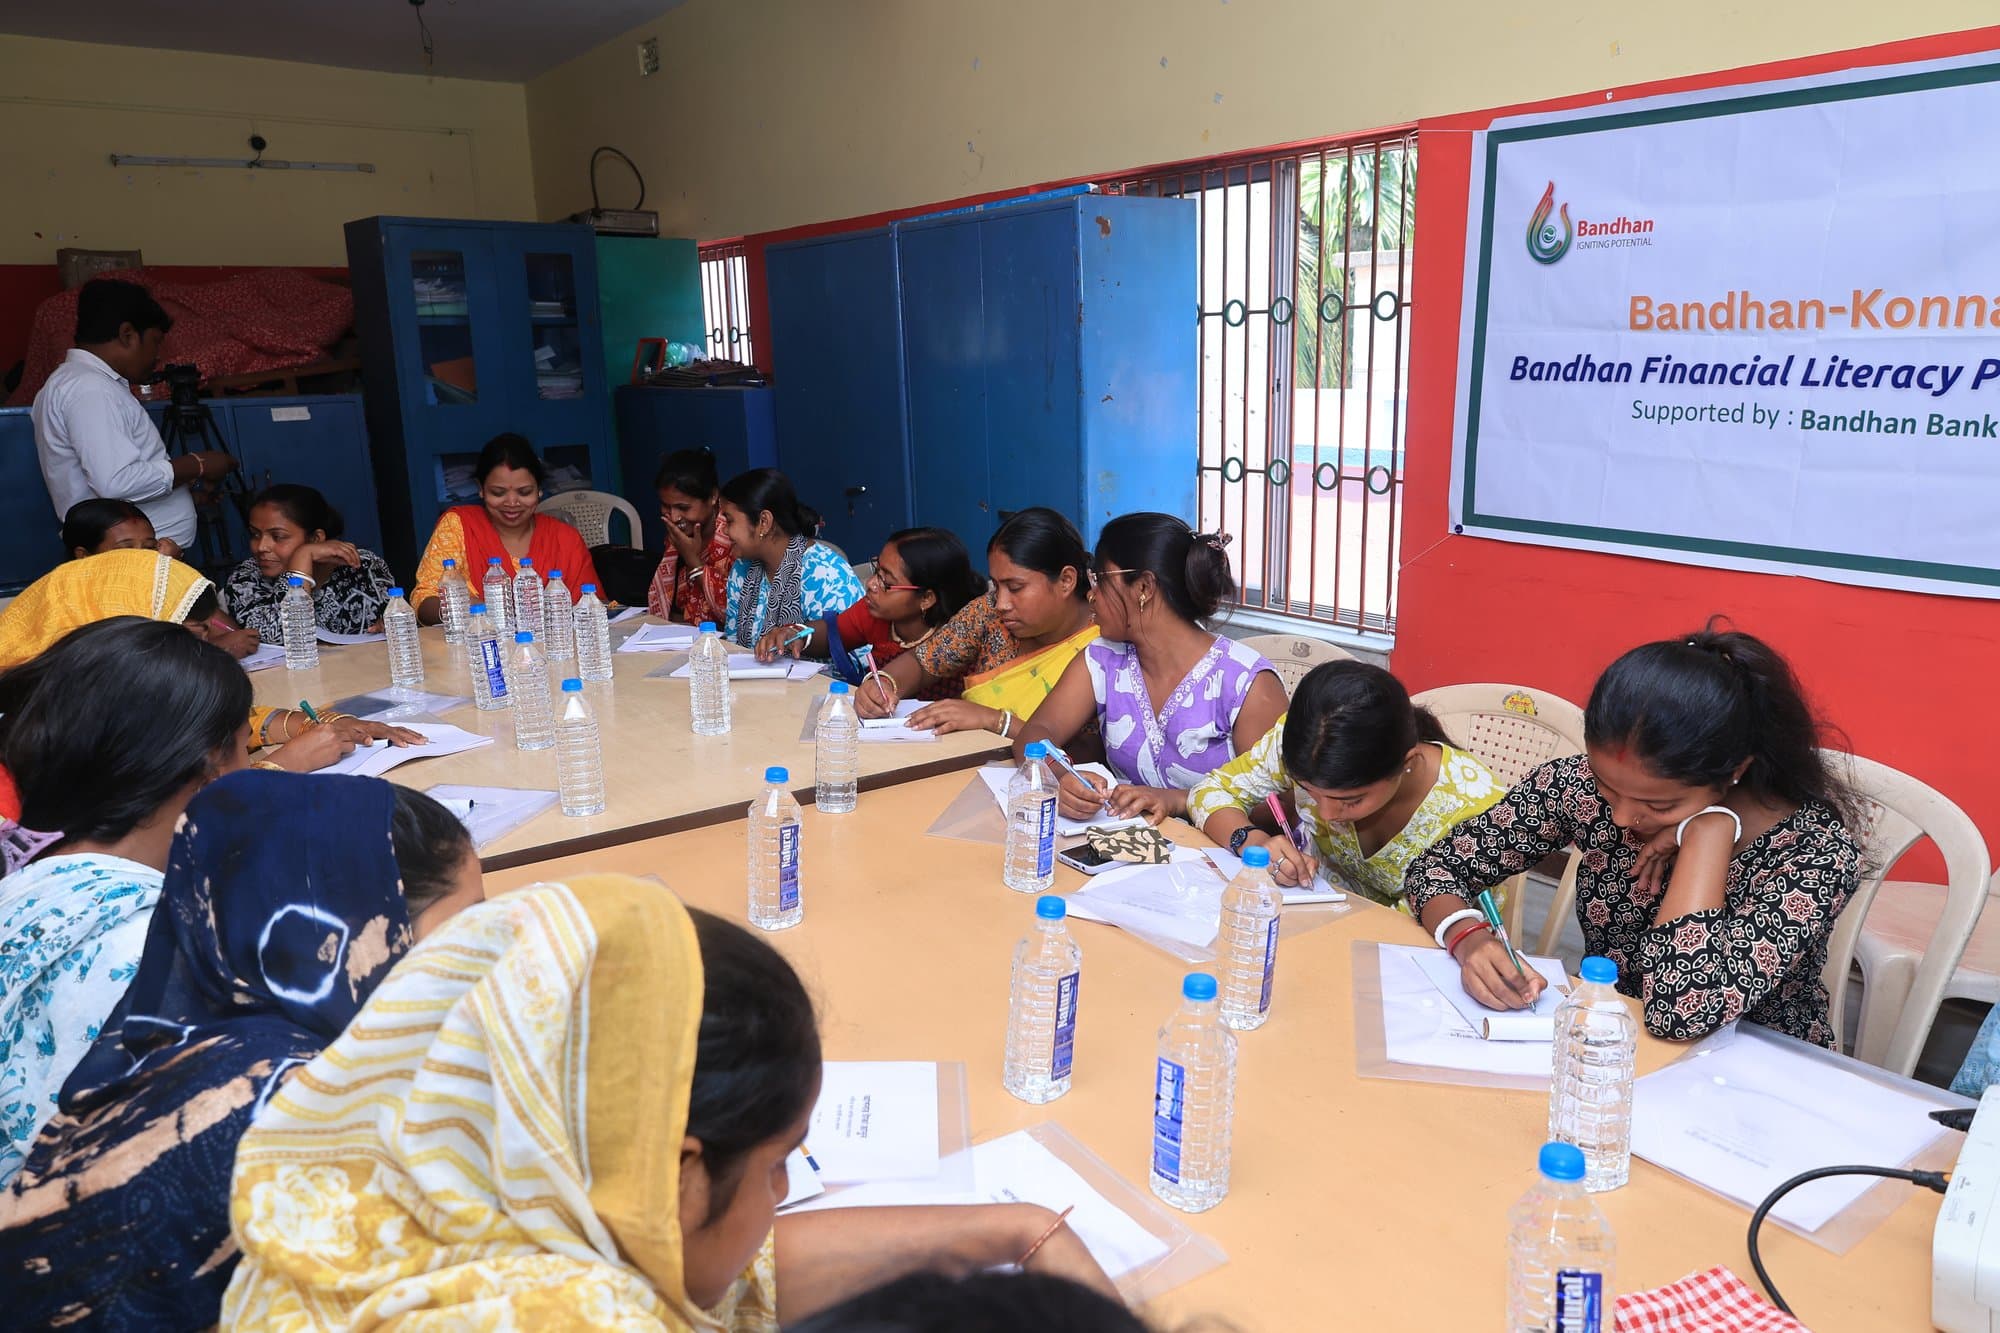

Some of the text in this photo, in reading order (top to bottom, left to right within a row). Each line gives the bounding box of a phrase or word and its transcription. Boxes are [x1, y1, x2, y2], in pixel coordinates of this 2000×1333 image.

[1576, 216, 1655, 237] Bandhan
[1576, 237, 1654, 250] IGNITING POTENTIAL
[1509, 353, 1633, 383] Bandhan
[1639, 354, 1796, 387] Financial
[1799, 354, 1965, 397] Literacy
[1631, 399, 1745, 425] Supported
[1752, 402, 1781, 430] by
[1800, 409, 1917, 435] Bandhan
[1926, 413, 1999, 439] Bank
[1057, 978, 1071, 1030] Natural
[1158, 1060, 1174, 1120] Natural
